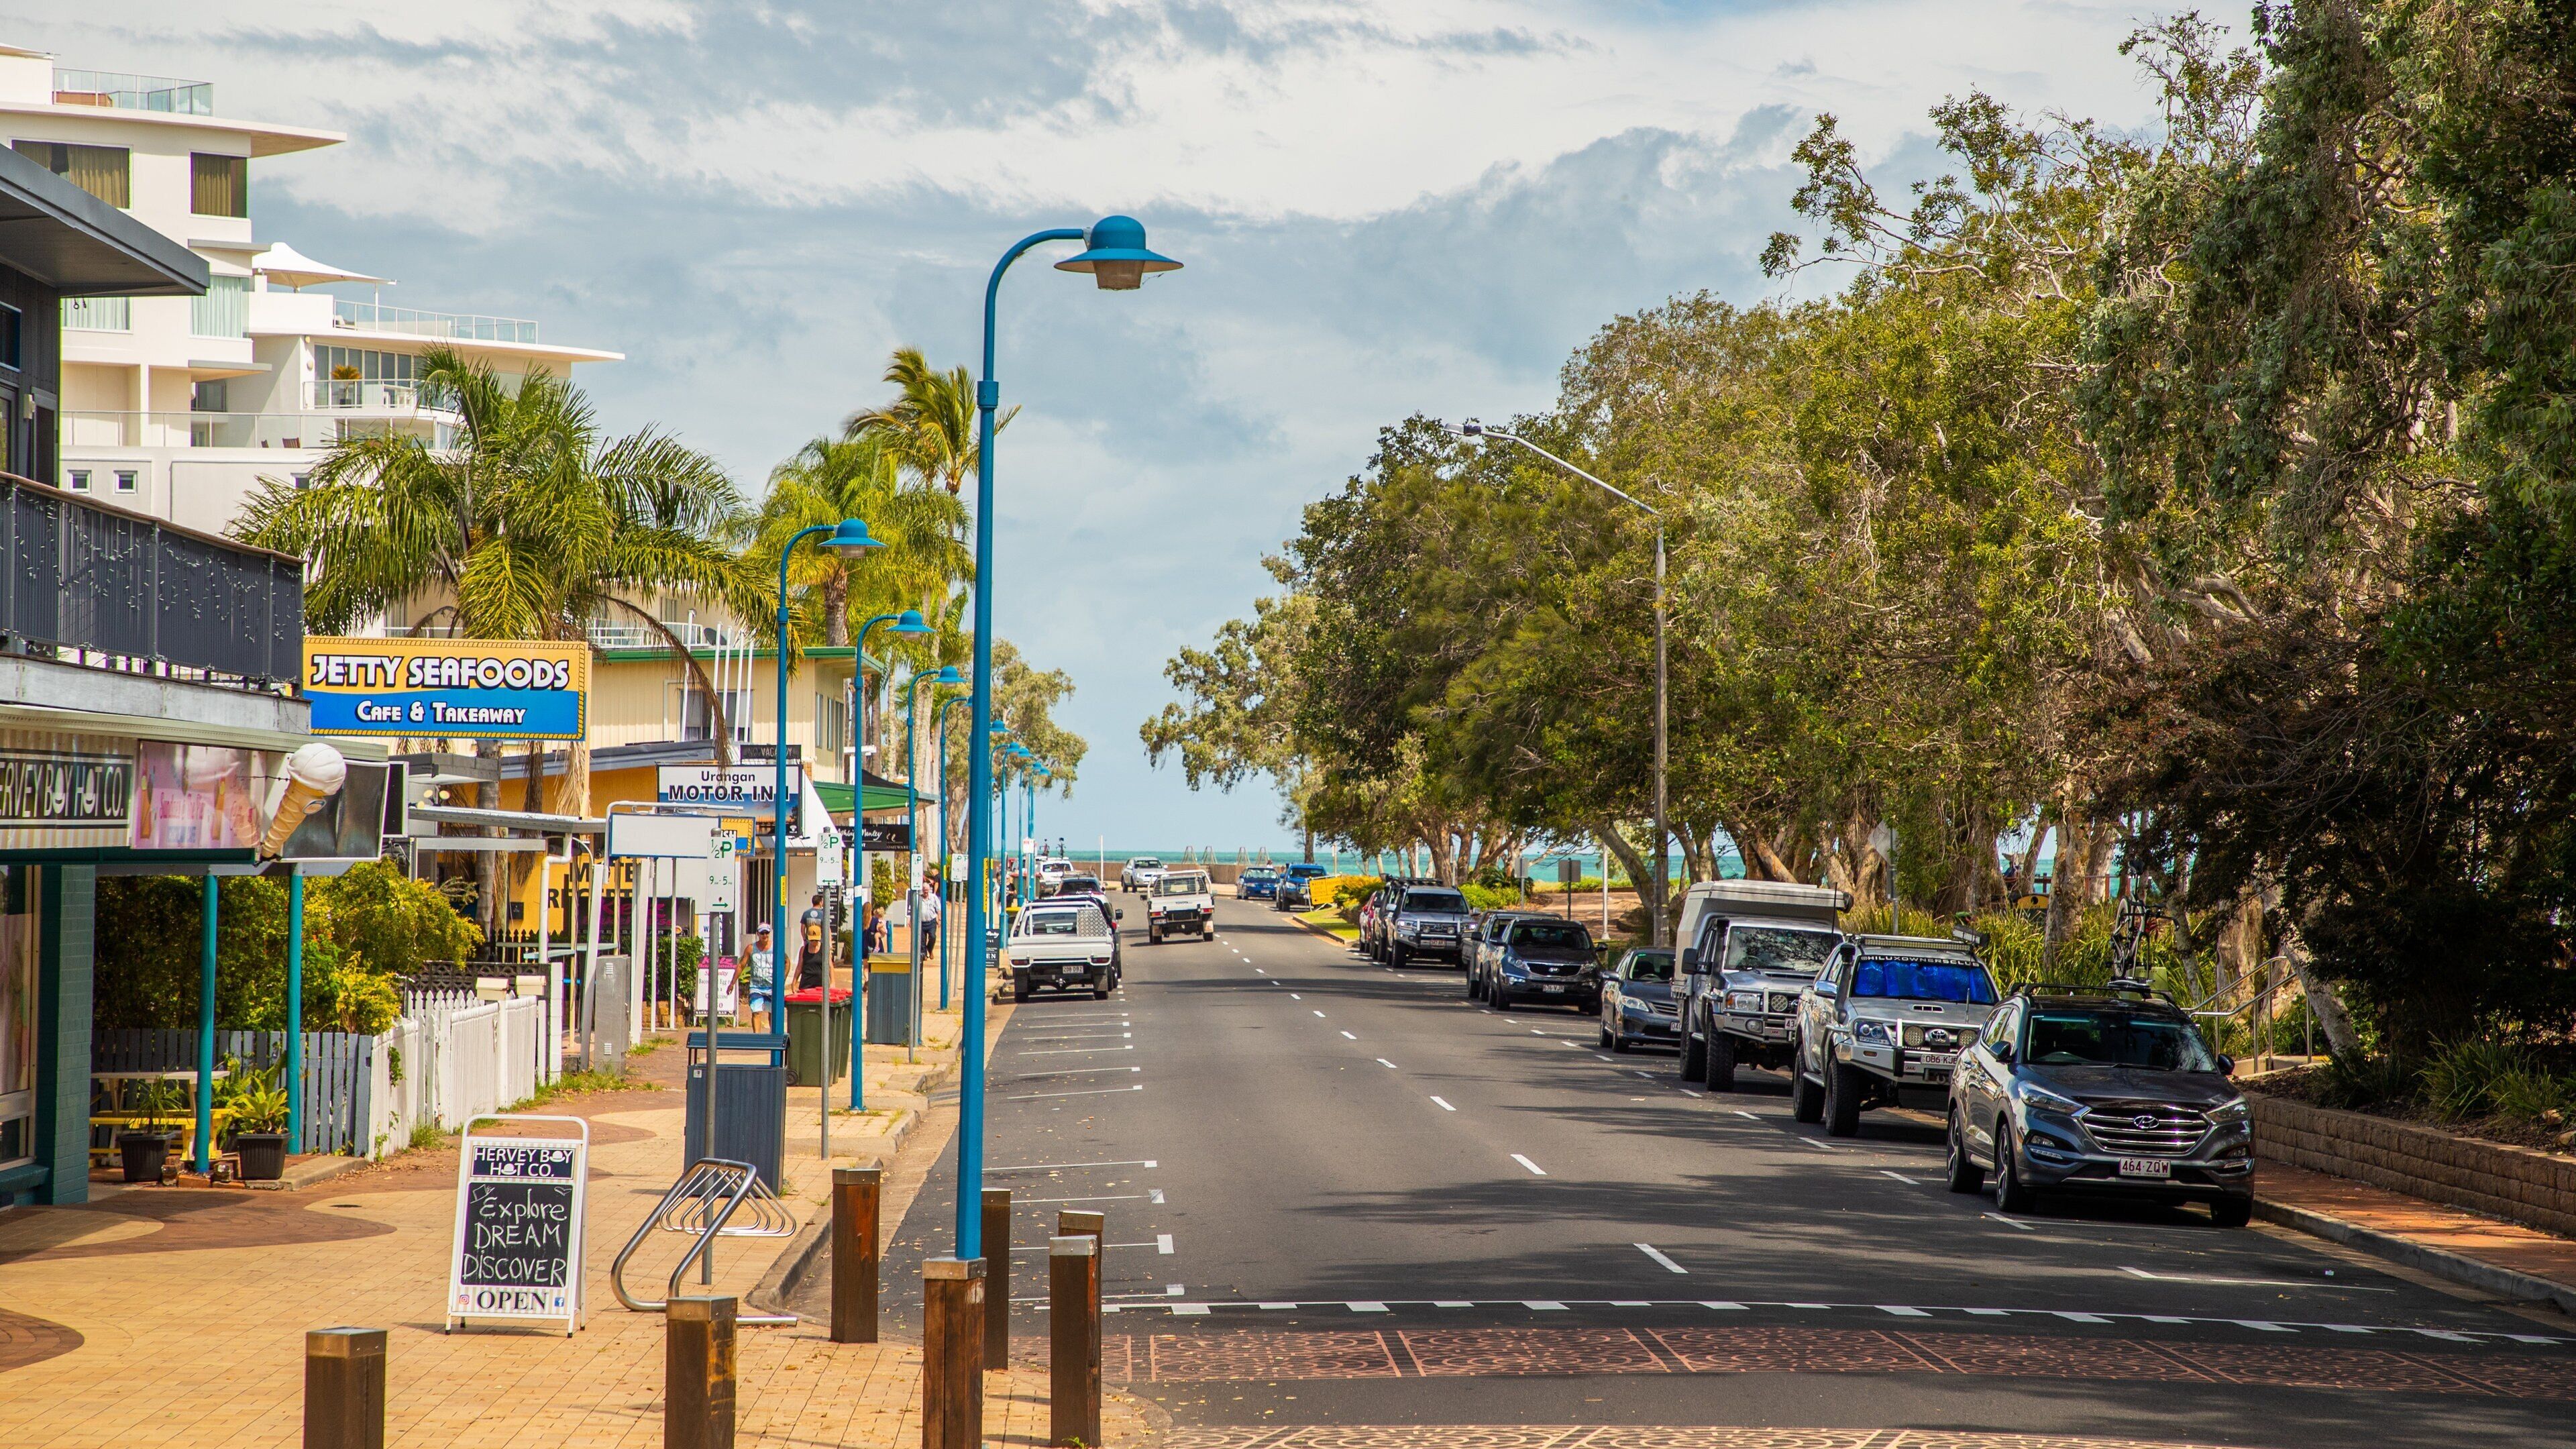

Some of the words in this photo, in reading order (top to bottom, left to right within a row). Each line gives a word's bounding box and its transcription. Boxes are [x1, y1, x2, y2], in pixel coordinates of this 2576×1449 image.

[311, 655, 403, 686] JETTY
[407, 657, 569, 690] SEAFOODS
[409, 701, 425, 722] &
[431, 702, 527, 724] TAKEAWAY
[761, 747, 792, 757] VACAY
[701, 771, 755, 784] Urangan
[0, 762, 43, 817] ERVEY
[104, 766, 123, 817] CO.
[669, 785, 743, 801] MOTOR
[752, 786, 790, 801] IN
[474, 1148, 537, 1163] HERVEY
[528, 1163, 554, 1177] CO.
[479, 1188, 568, 1224] Explore
[474, 1222, 561, 1250] DREAM
[462, 1250, 567, 1287] DISCOVER
[476, 1291, 549, 1311] OPEN
